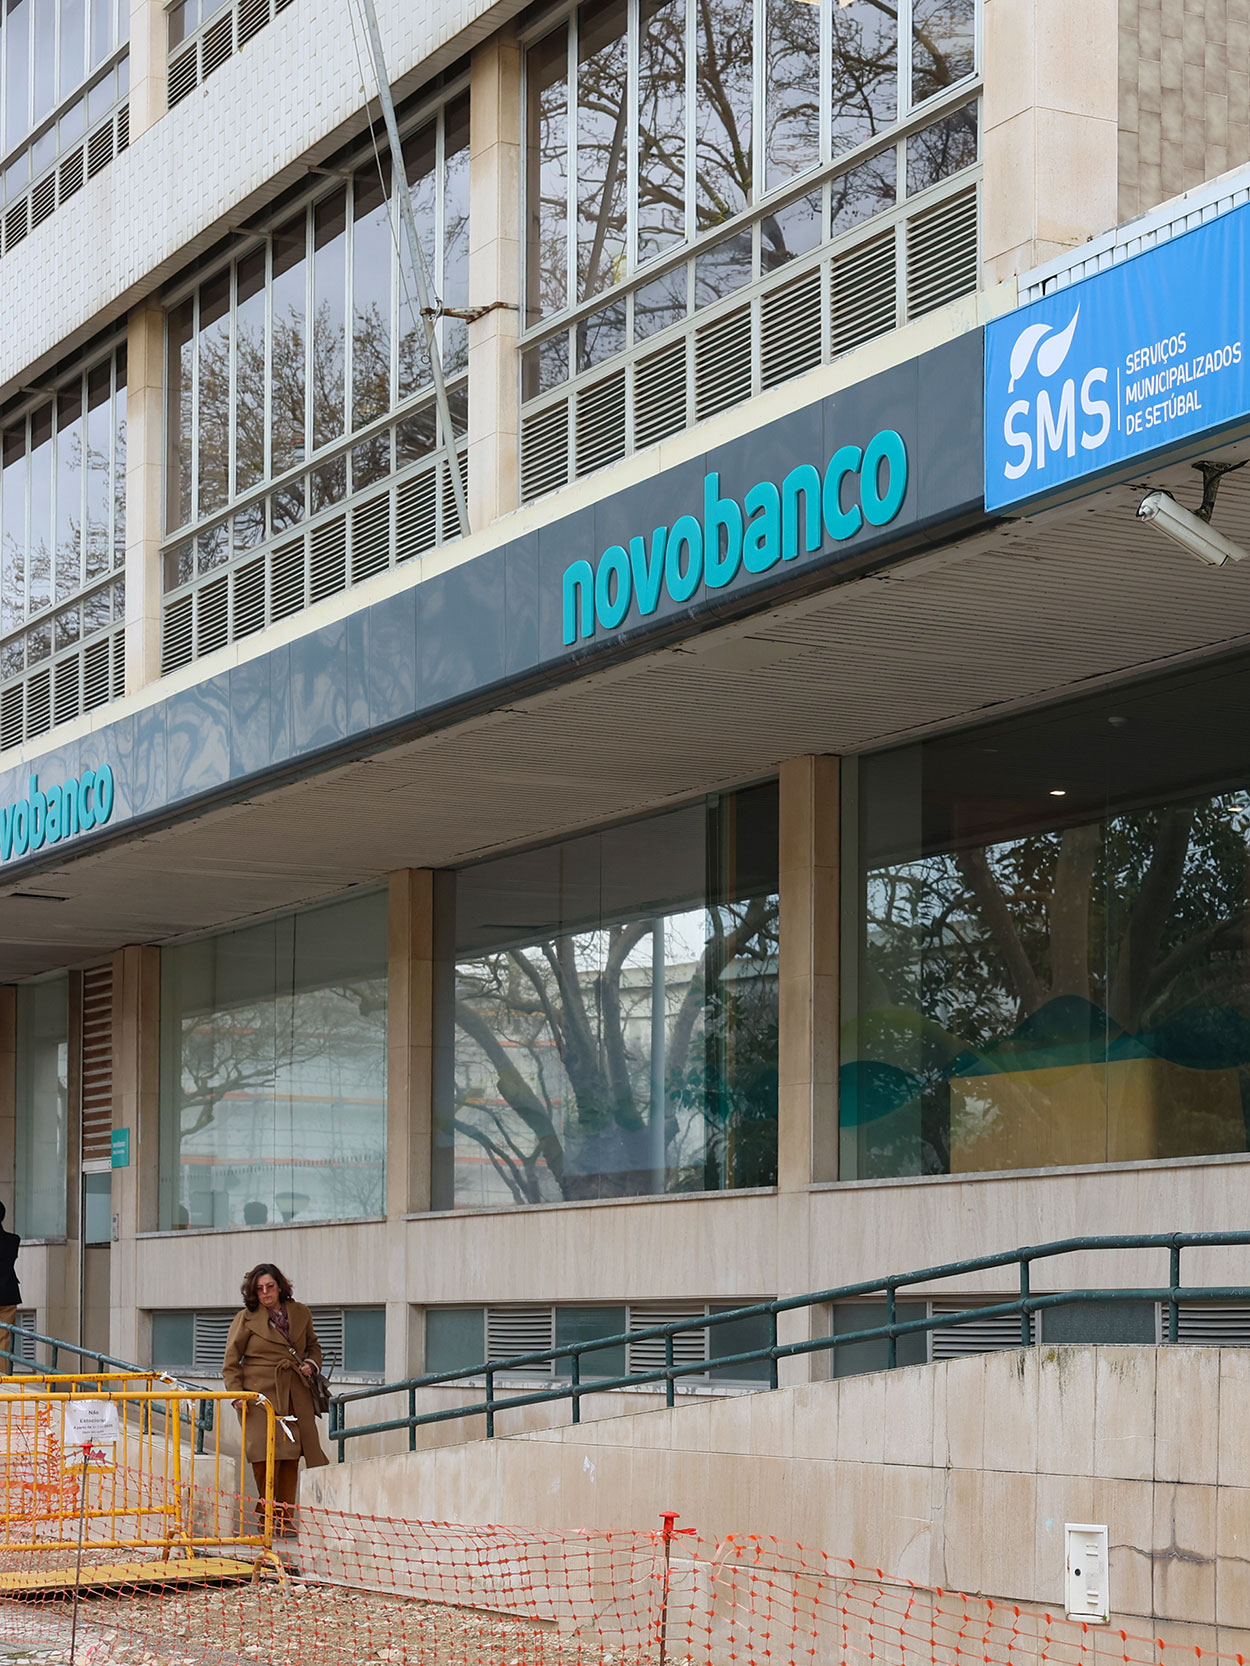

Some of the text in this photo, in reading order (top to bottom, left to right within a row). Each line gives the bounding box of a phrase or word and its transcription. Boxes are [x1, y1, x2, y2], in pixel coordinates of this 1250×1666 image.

[1125, 332, 1187, 375] SERVIÇOS
[1125, 341, 1242, 406] MUNICIPALIZADOS
[1003, 367, 1111, 480] SMS
[1126, 389, 1203, 436] DE SETÚBAL
[562, 429, 908, 646] novobanco
